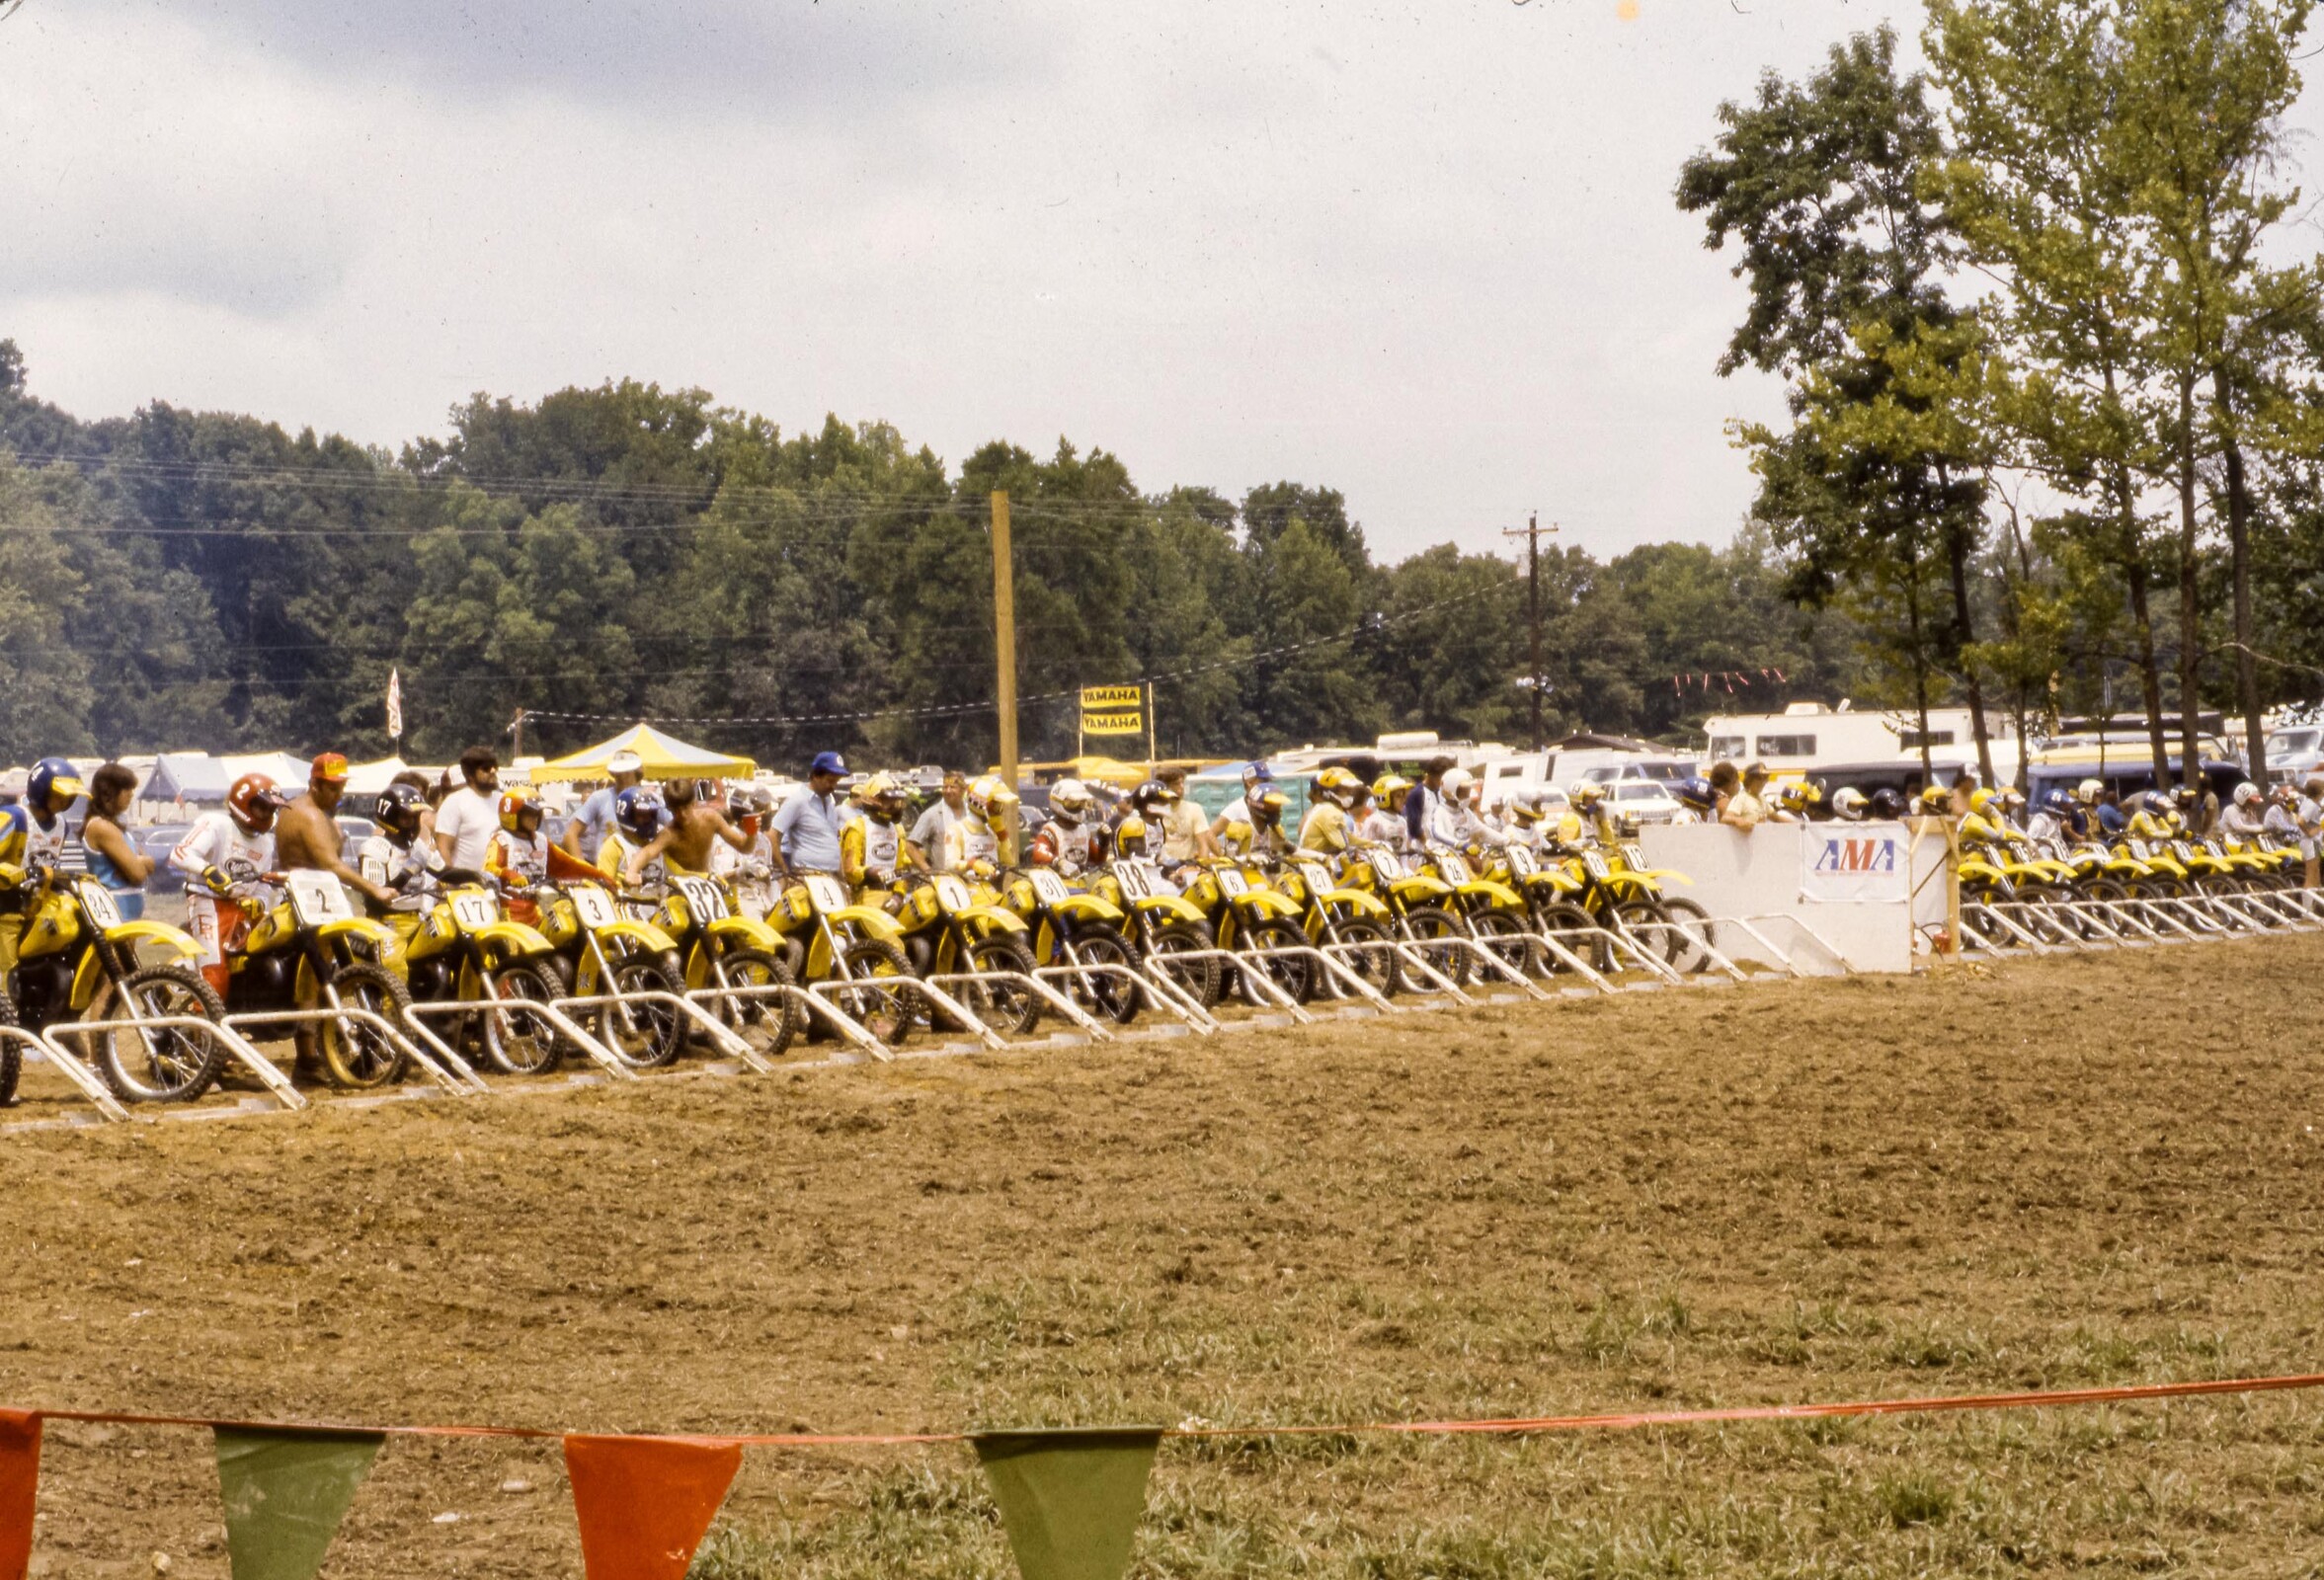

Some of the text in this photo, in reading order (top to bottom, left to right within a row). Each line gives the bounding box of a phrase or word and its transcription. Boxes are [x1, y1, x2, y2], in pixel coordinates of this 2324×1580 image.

[1083, 690, 1139, 702] YAMAHA
[1083, 717, 1140, 729] YAMAHA
[237, 783, 250, 800] 2
[377, 798, 392, 817] 17
[1517, 850, 1532, 873] 9
[1814, 838, 1895, 871] AMA
[1039, 876, 1062, 899] 31
[1116, 863, 1152, 897] 38
[1229, 875, 1240, 893] 6
[315, 888, 332, 914] 2
[823, 885, 834, 906] 4
[459, 900, 486, 923] 17
[588, 899, 602, 921] 3
